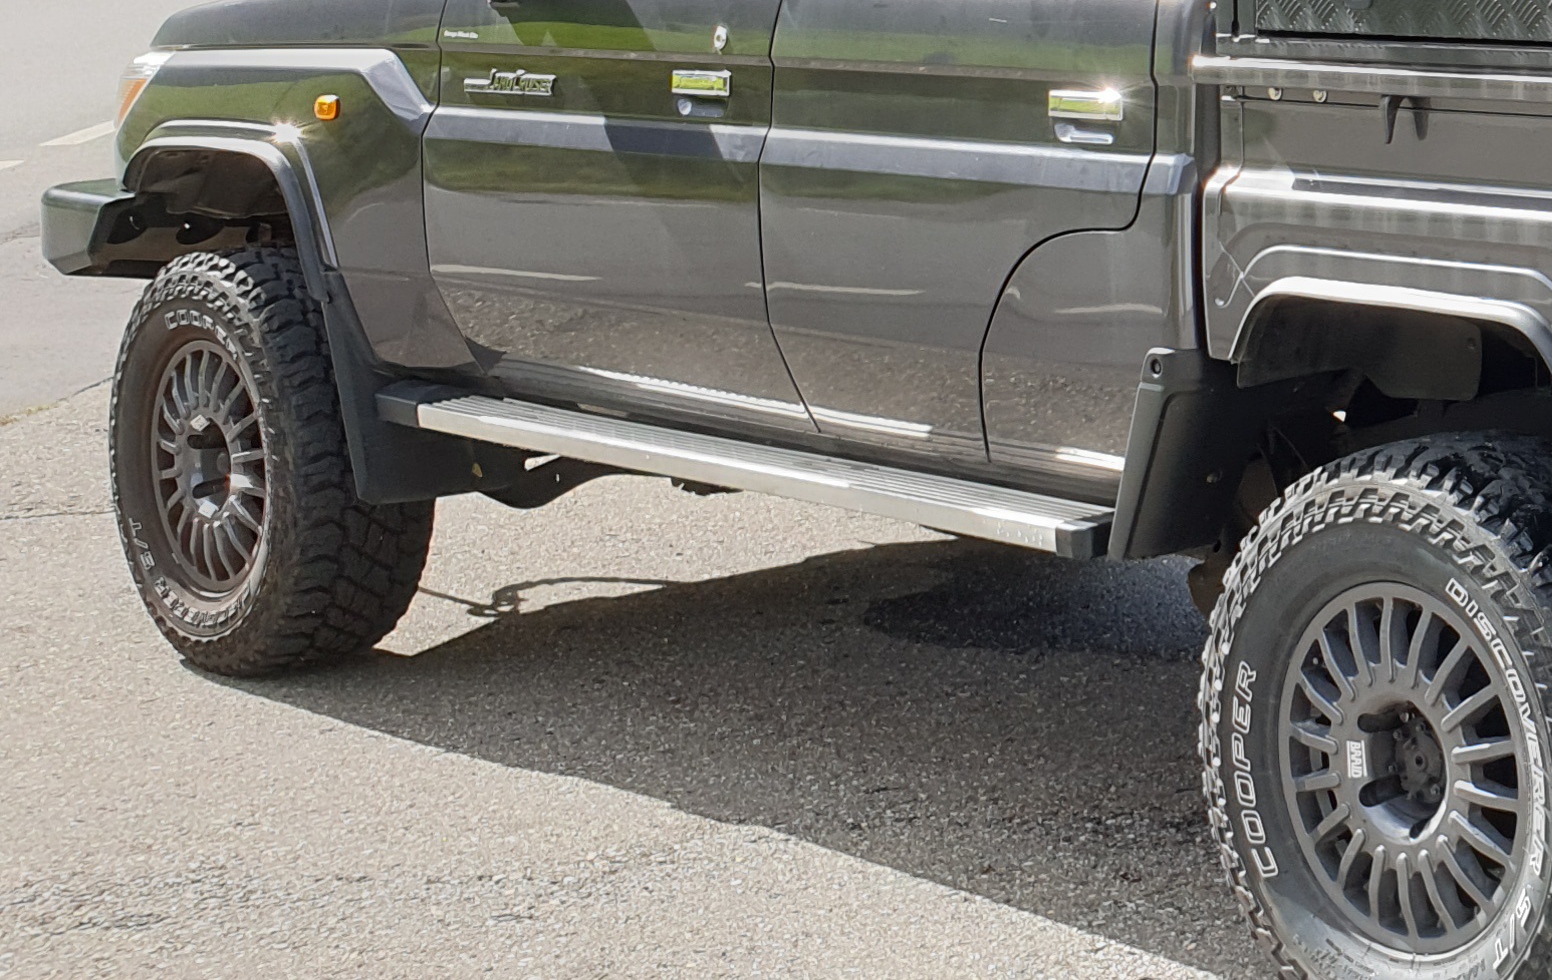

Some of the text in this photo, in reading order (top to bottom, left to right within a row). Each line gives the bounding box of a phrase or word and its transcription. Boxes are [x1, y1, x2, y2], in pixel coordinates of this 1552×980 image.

[164, 309, 238, 360] COOPER
[1349, 740, 1363, 778] BRAID
[1445, 577, 1549, 877] DISCOVERER
[1231, 660, 1279, 878] COOPER
[1492, 890, 1531, 970] S/T
